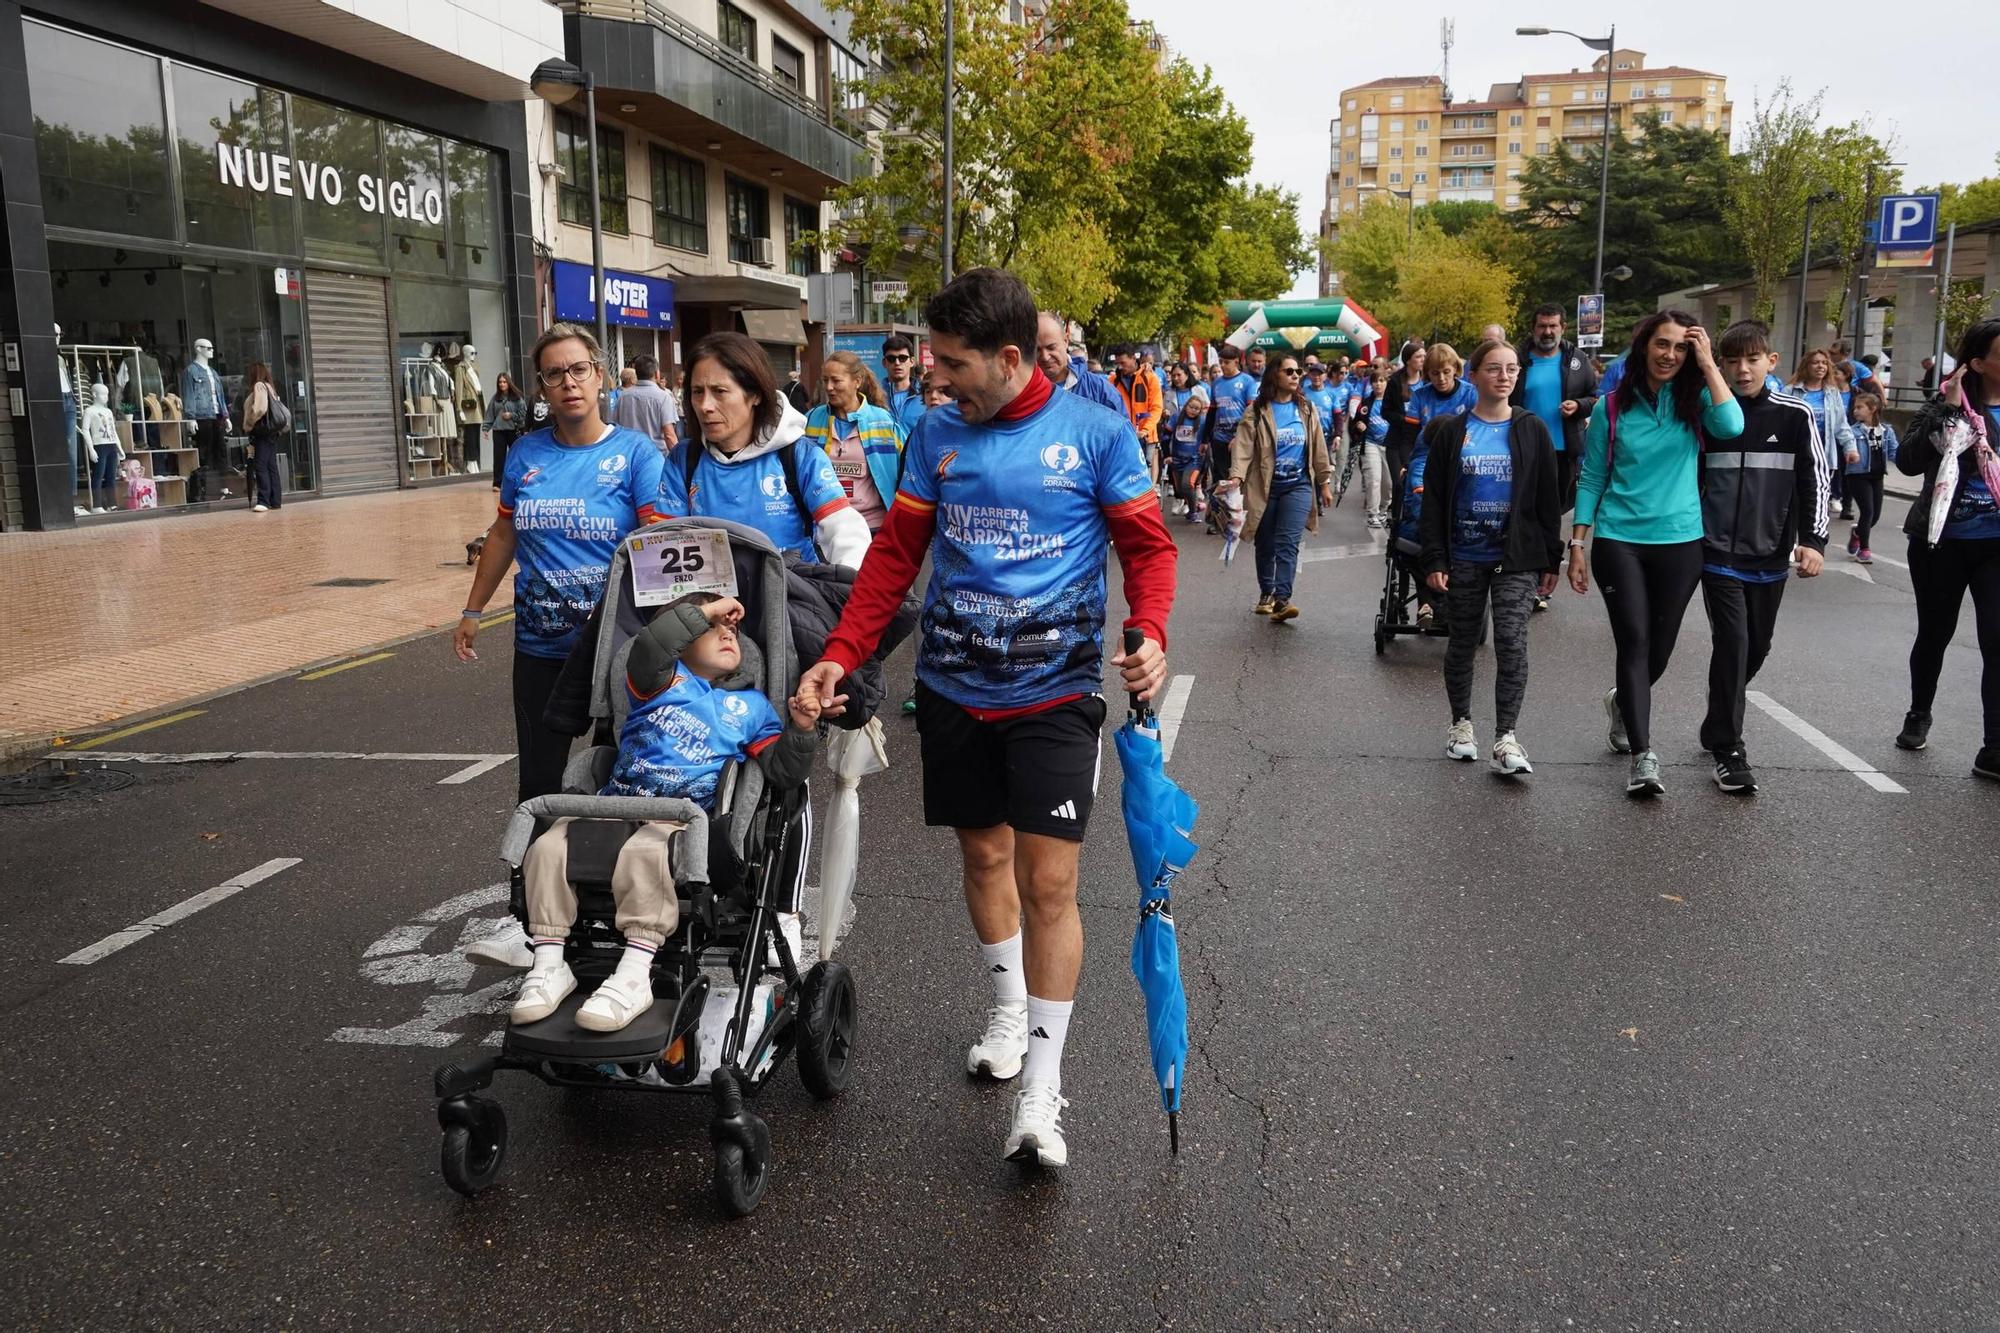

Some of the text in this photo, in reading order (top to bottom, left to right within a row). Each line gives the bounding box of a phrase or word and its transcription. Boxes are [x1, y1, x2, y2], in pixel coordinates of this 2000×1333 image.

[217, 142, 442, 225] NUEVO SIGLO
[1892, 200, 1924, 240] P
[1318, 335, 1348, 344] RURAL
[834, 464, 862, 474] RWAY
[1461, 455, 1481, 467] XIV
[1495, 474, 1513, 482] ZAM
[515, 498, 586, 517] XIV CARRERA
[540, 507, 586, 516] POPULAR
[943, 502, 1029, 527] XIV CARRERA
[514, 515, 618, 531] GUARDIA CIVIL
[973, 517, 1029, 533] POPULAR
[564, 529, 617, 541] ZAMORA
[944, 524, 1067, 549] GUARDIA CIVIL
[660, 545, 704, 574] 25
[994, 546, 1063, 561] ZAMORA
[674, 573, 694, 583] ENZO
[953, 600, 1032, 618] CAJA RURAL
[971, 633, 1006, 647] feder
[670, 710, 707, 742] POPULAR
[674, 706, 712, 736] CARRERA
